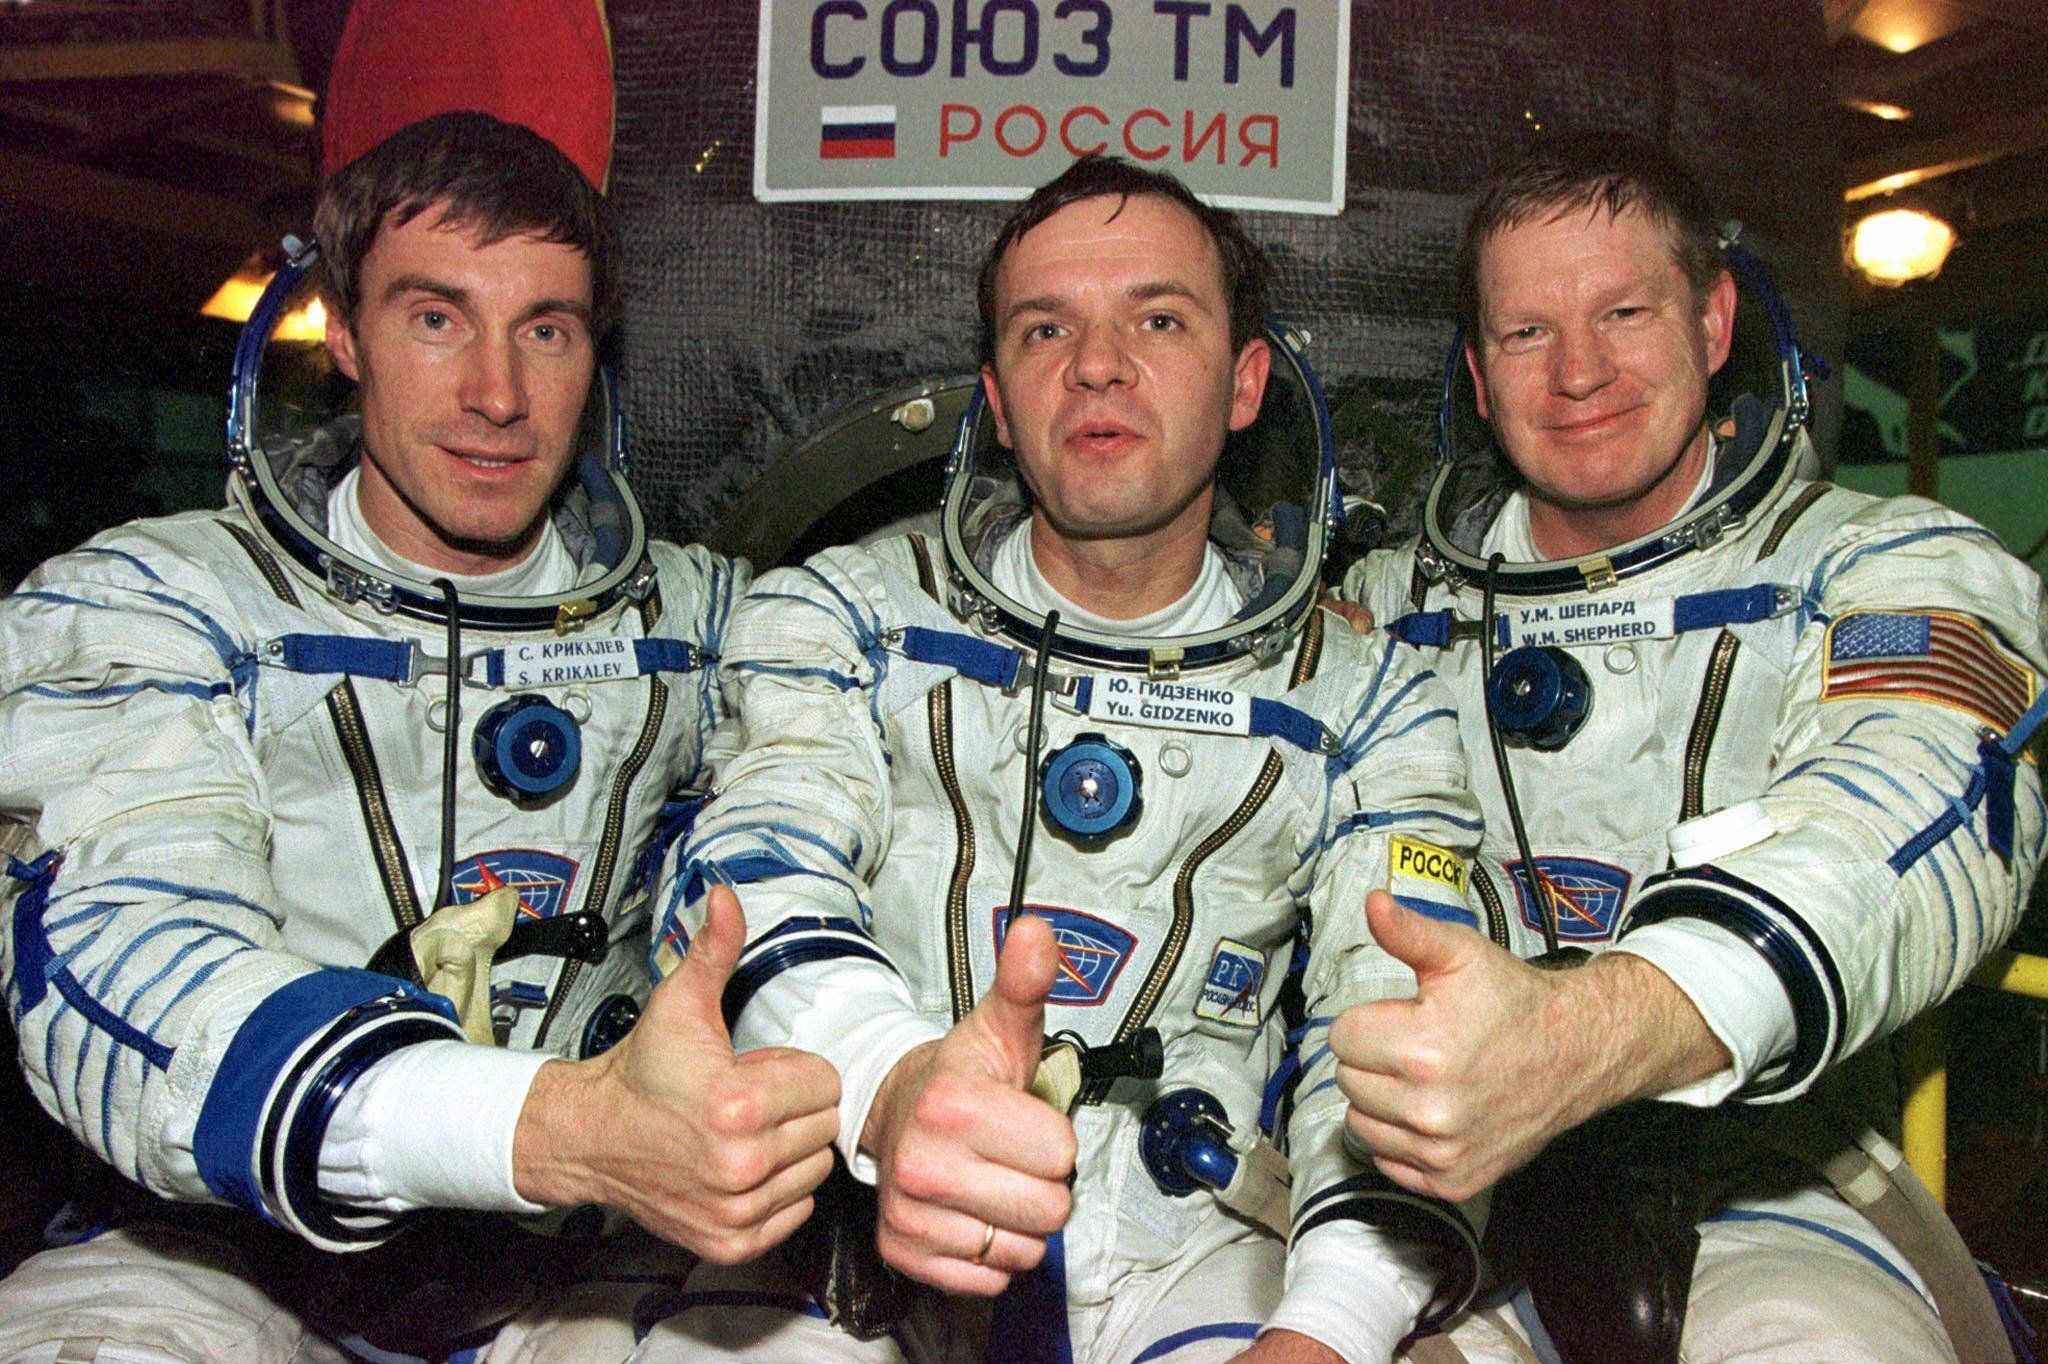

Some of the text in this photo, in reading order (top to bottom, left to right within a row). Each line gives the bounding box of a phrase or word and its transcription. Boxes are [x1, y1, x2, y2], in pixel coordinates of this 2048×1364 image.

[809, 0, 1297, 88] СОЮЗ ТМ
[939, 103, 1280, 169] РОССИЯ
[1558, 600, 1636, 620] ШЕПАРД
[1521, 620, 1656, 647] W.M. SHEPHERD
[518, 639, 625, 661] С. КРИКАЛЕВ
[518, 662, 622, 685] S. KRIKALEV
[1108, 677, 1234, 705] Ю. ГИДЗЕНКО
[1106, 701, 1234, 727] Yu. GIDZENKO
